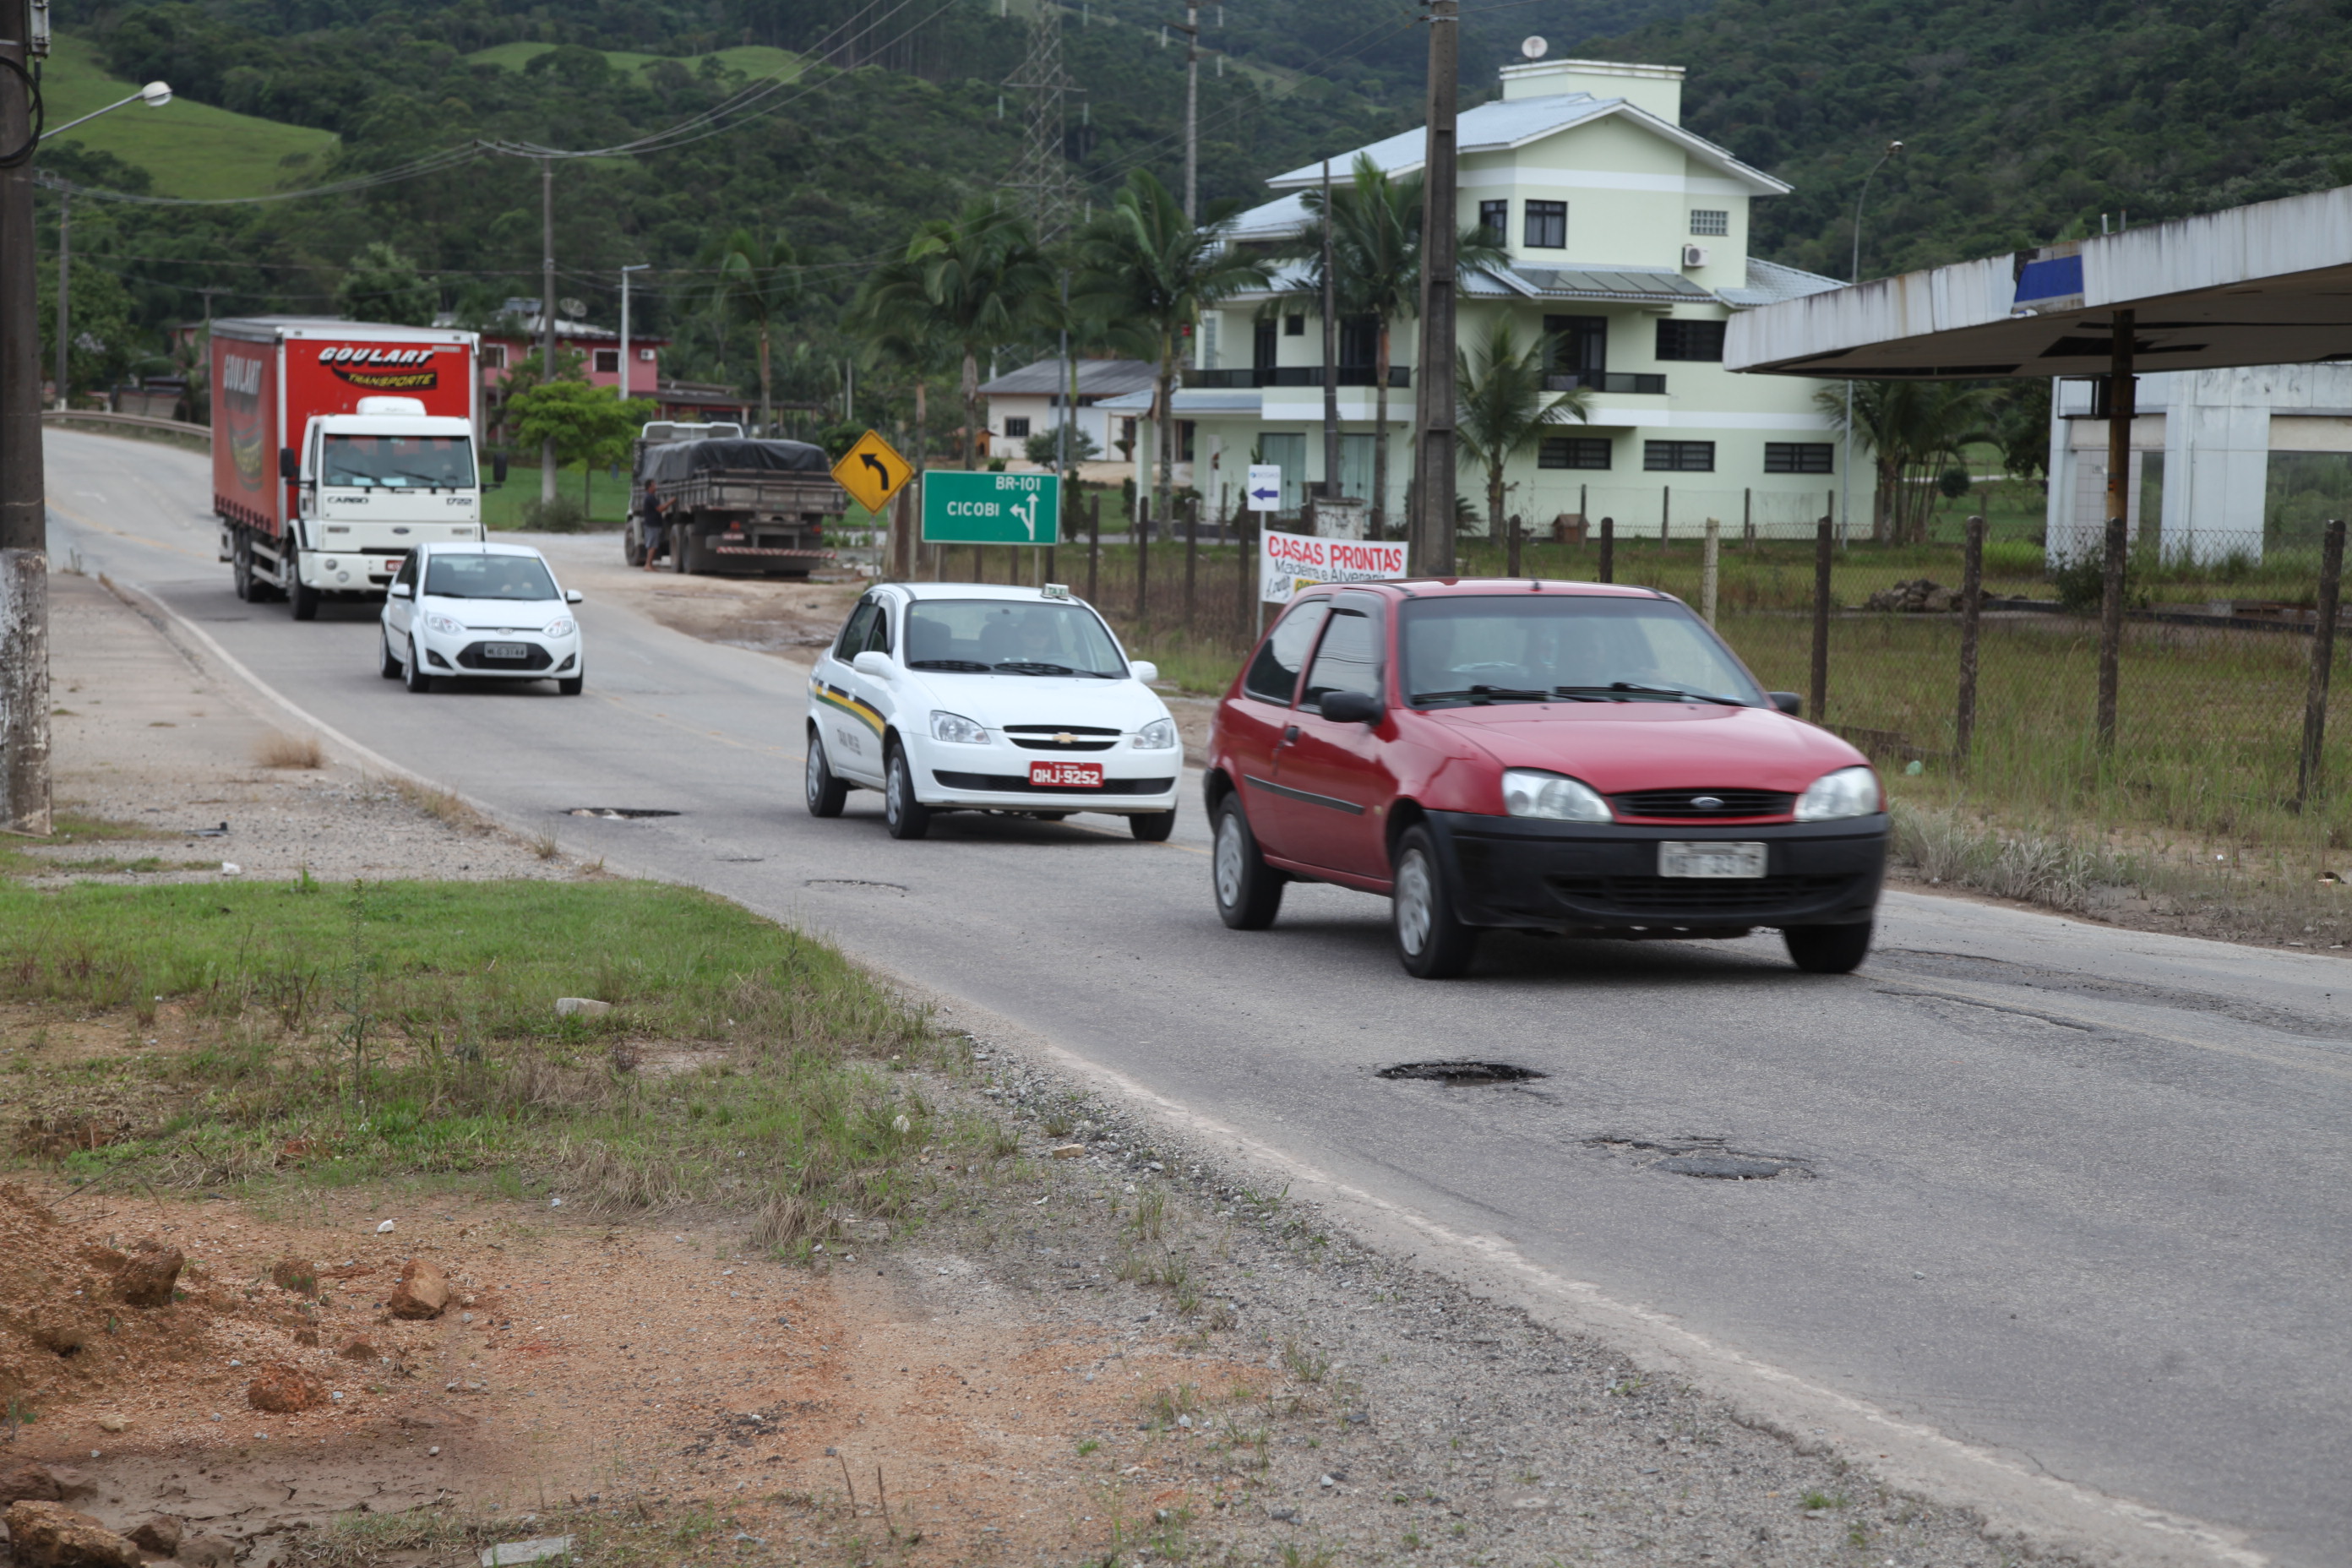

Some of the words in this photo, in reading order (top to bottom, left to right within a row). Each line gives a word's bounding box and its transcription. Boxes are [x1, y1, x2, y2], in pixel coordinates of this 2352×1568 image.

[318, 347, 433, 364] GOULART
[348, 373, 434, 387] TRANSPORTE
[995, 476, 1041, 491] BR-101
[327, 496, 369, 504] CARGO
[947, 501, 999, 516] CICOBI
[1269, 536, 1324, 565] CASAS
[1330, 544, 1402, 572] PRONTAS
[1275, 559, 1320, 580] Madeira
